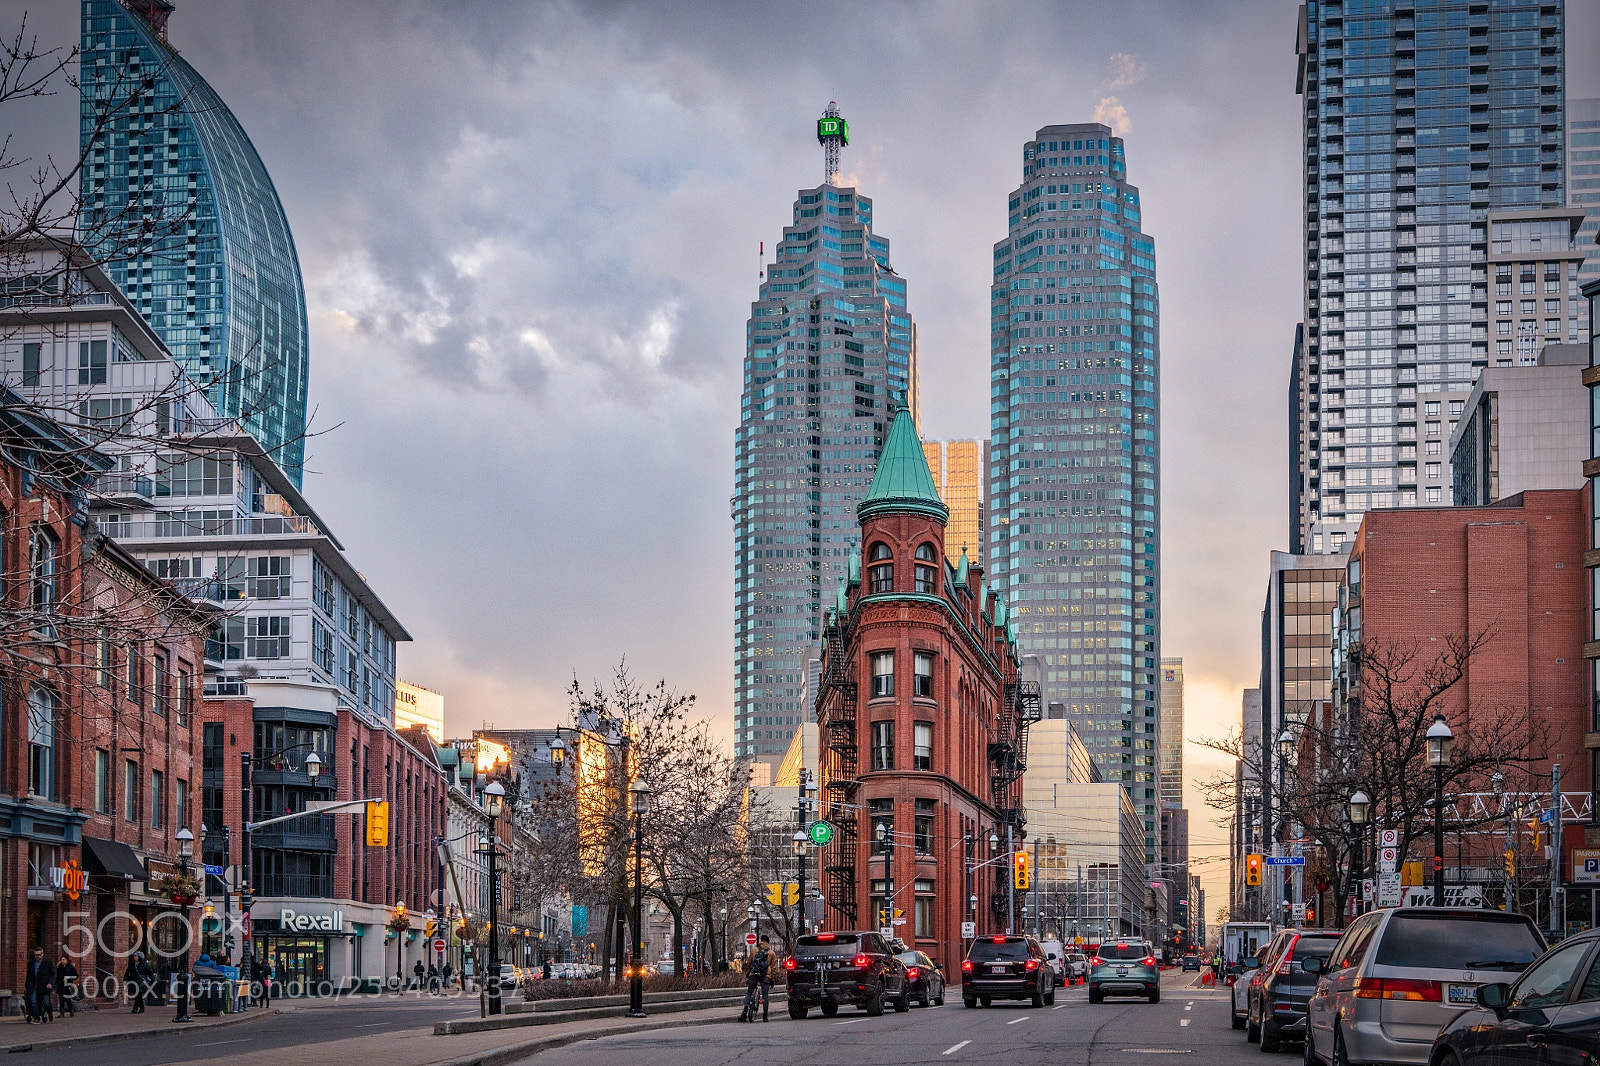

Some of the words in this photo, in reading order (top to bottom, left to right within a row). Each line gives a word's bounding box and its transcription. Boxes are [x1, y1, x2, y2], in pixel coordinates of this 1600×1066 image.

[823, 121, 837, 132] TD
[395, 690, 416, 705] ELUS
[816, 826, 827, 838] P
[1587, 860, 1596, 871] P
[1444, 888, 1464, 897] HE
[281, 908, 343, 932] Rexall
